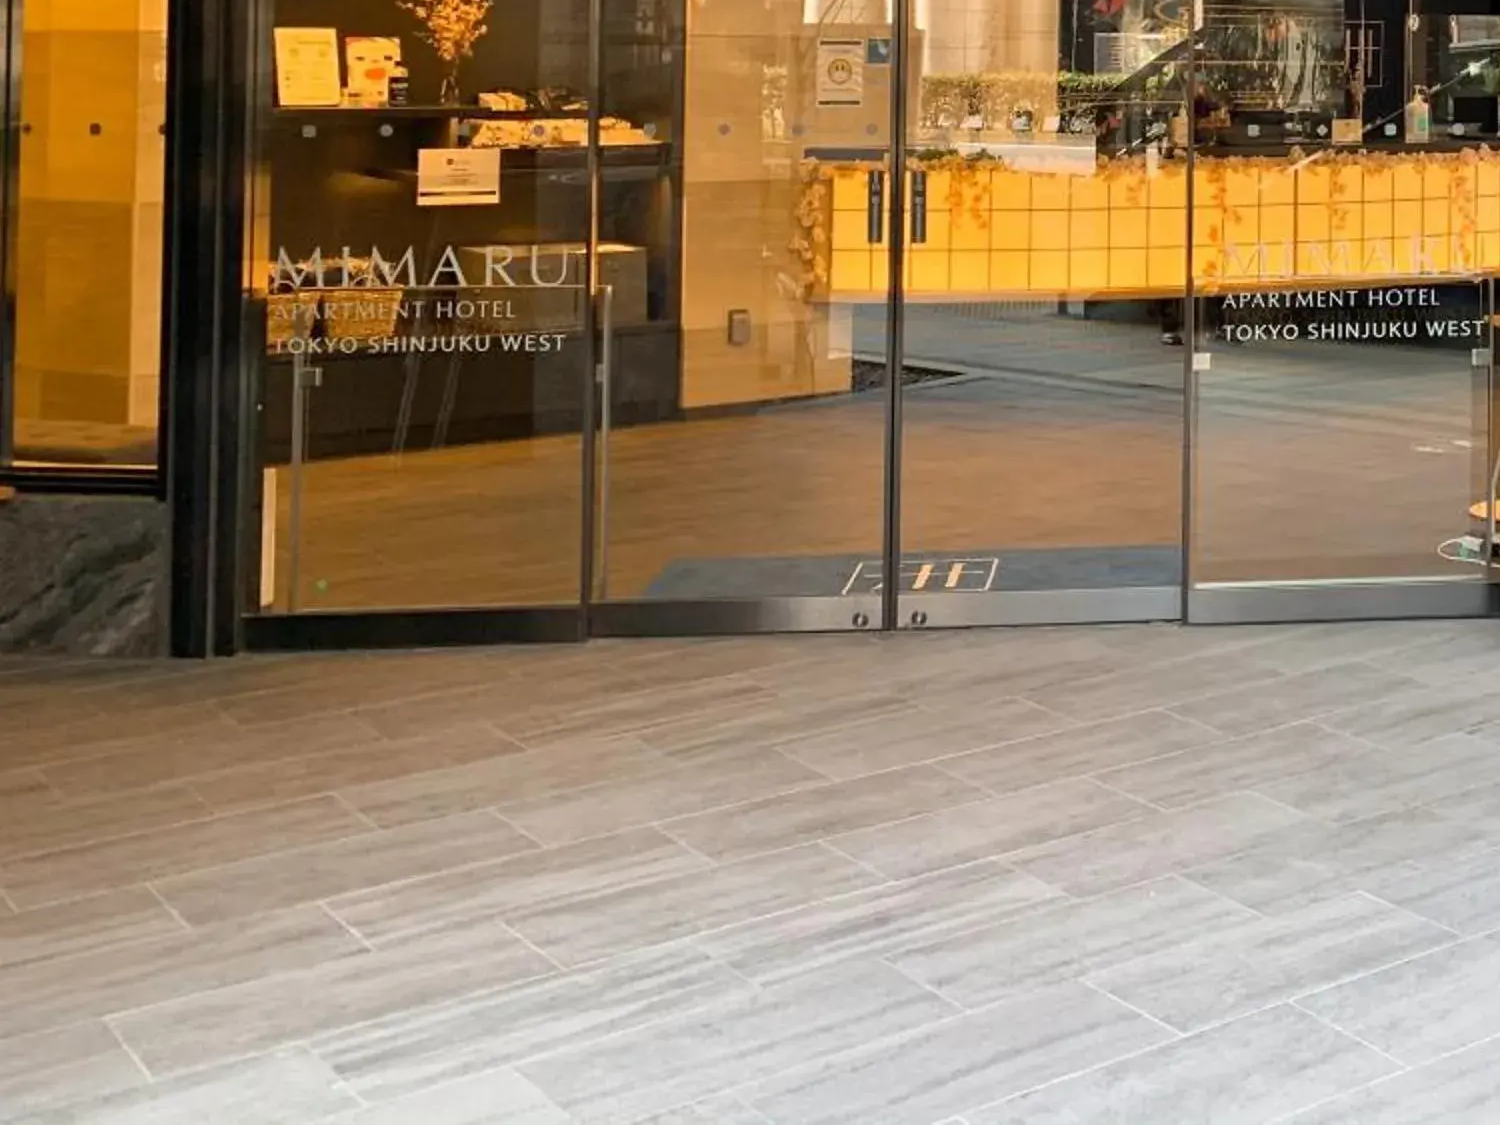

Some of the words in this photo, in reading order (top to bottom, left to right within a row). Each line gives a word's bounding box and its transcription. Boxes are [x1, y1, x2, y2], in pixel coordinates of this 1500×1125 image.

[274, 245, 568, 290] MIMARU
[1222, 290, 1358, 309] APARTMENT
[1368, 288, 1440, 307] HOTEL
[275, 300, 426, 321] APARTMENT
[436, 300, 516, 318] HOTEL
[1223, 324, 1299, 342] TOKYO
[1307, 322, 1417, 340] SHINJUKU
[1425, 320, 1485, 338] WEST
[274, 336, 358, 354] TOKYO
[367, 334, 490, 354] SHINJUKU
[501, 334, 567, 352] WEST
